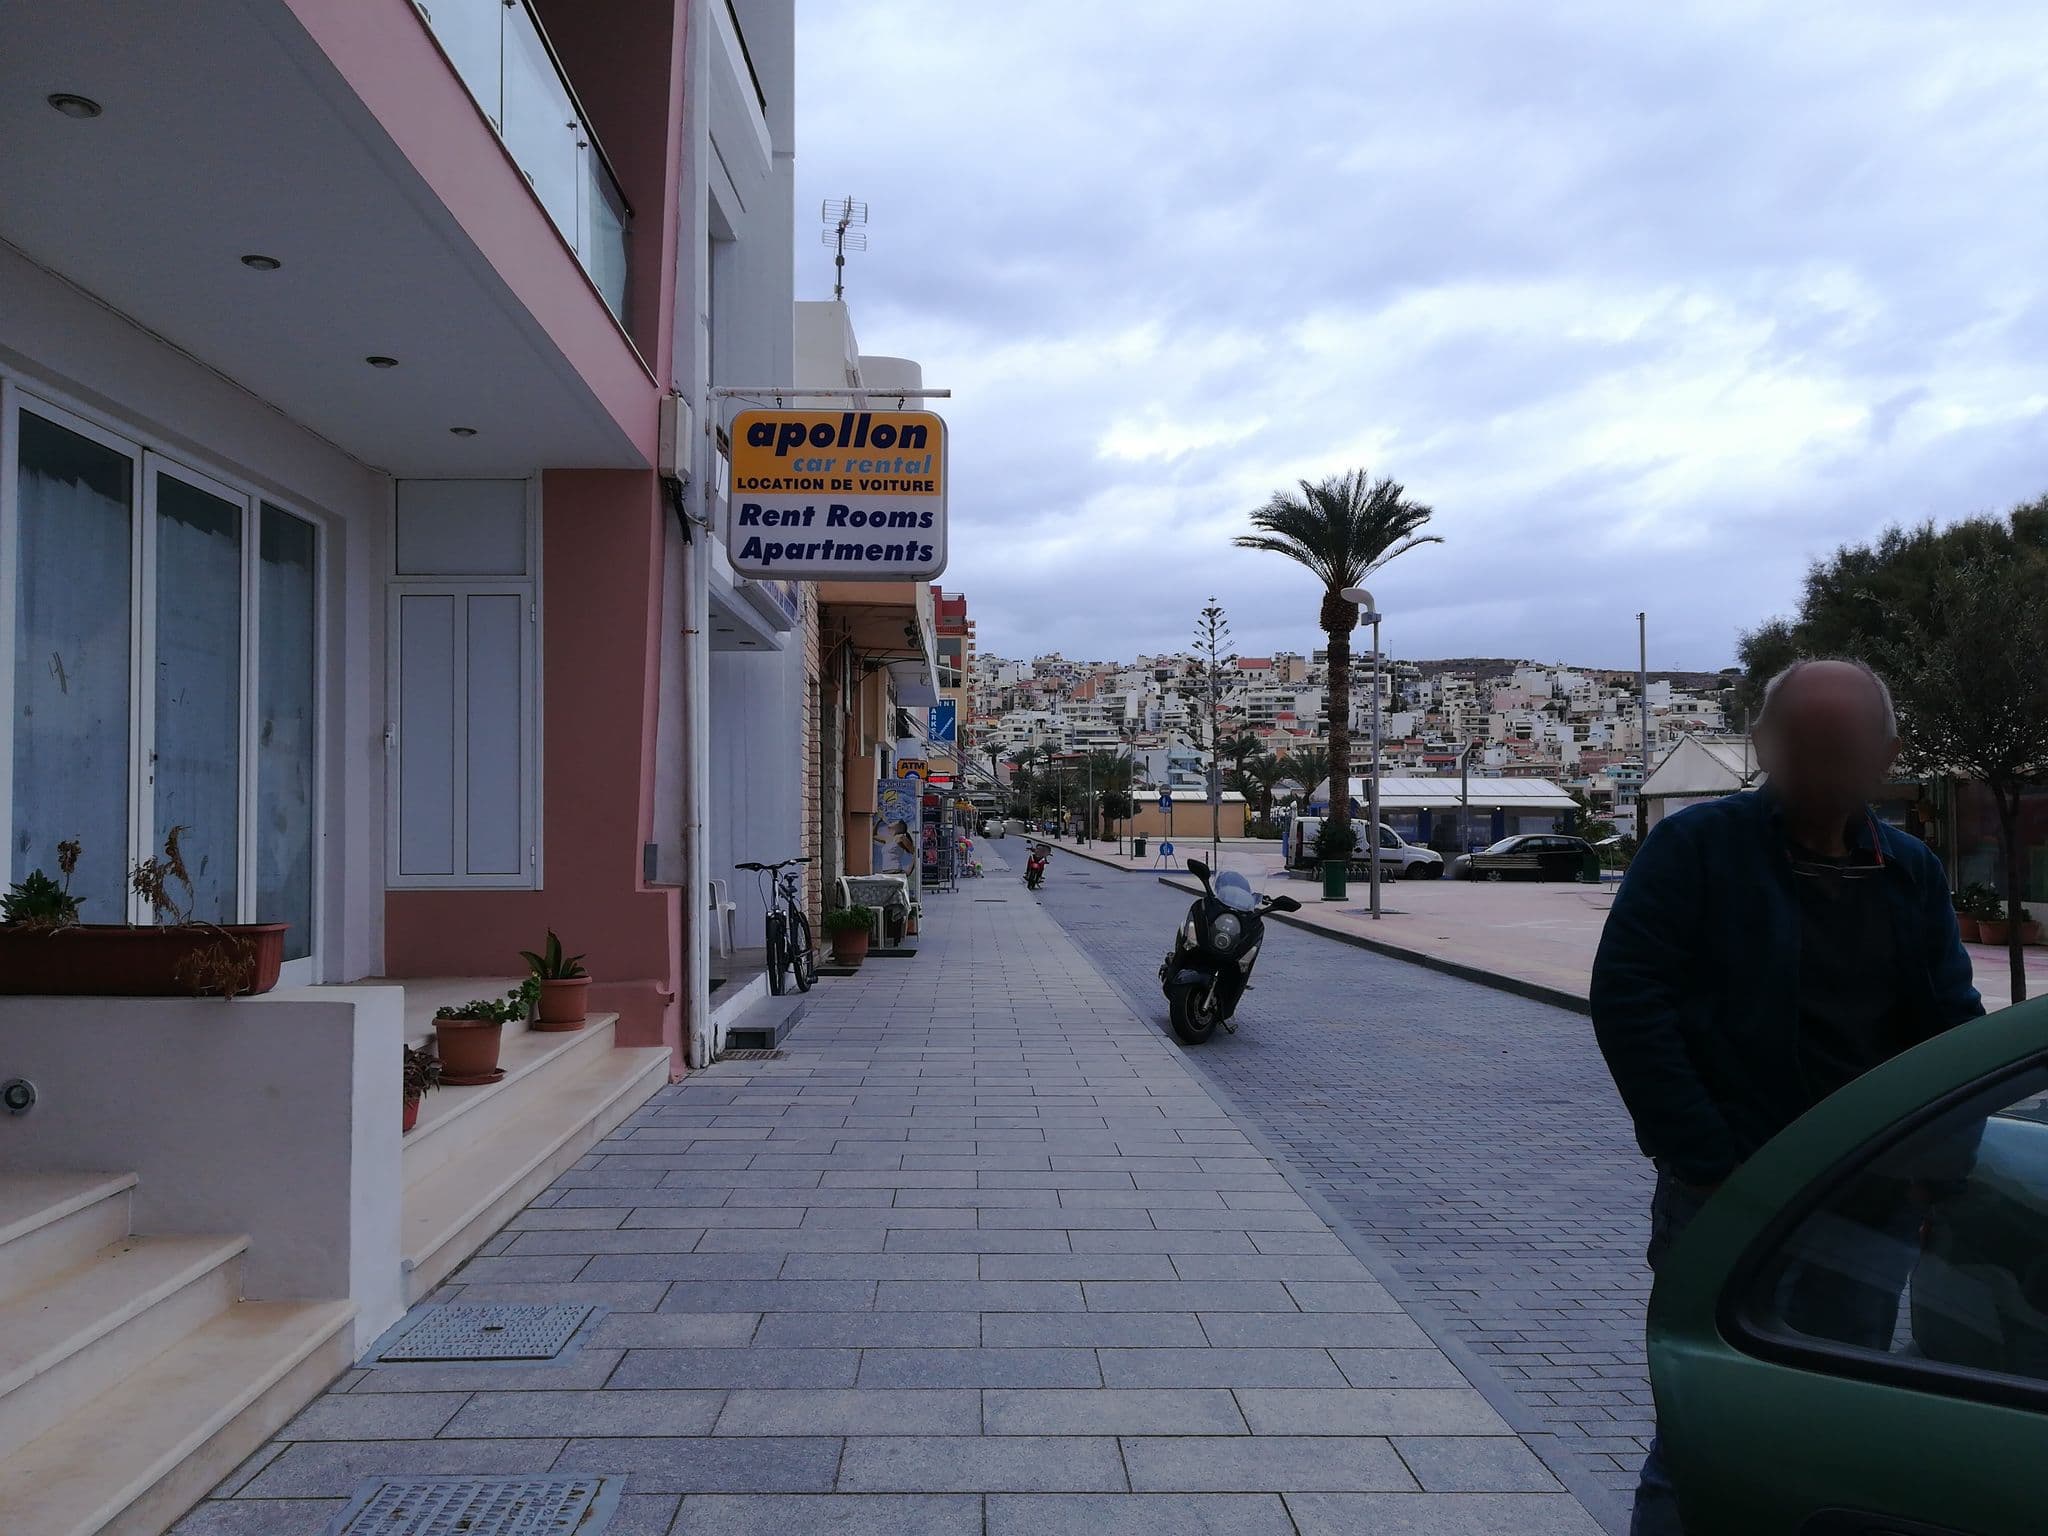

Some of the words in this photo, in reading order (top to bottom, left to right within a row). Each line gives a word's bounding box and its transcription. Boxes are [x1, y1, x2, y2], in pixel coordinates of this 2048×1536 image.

[746, 412, 928, 457] apollon
[793, 457, 837, 473] car
[845, 454, 932, 475] rental
[737, 477, 824, 490] LOCATION
[831, 479, 853, 490] DE
[859, 479, 935, 492] VOITURE
[738, 503, 816, 527] Rent
[826, 504, 934, 528] Rooms
[738, 536, 934, 566] Apartments
[901, 762, 925, 770] ATM
